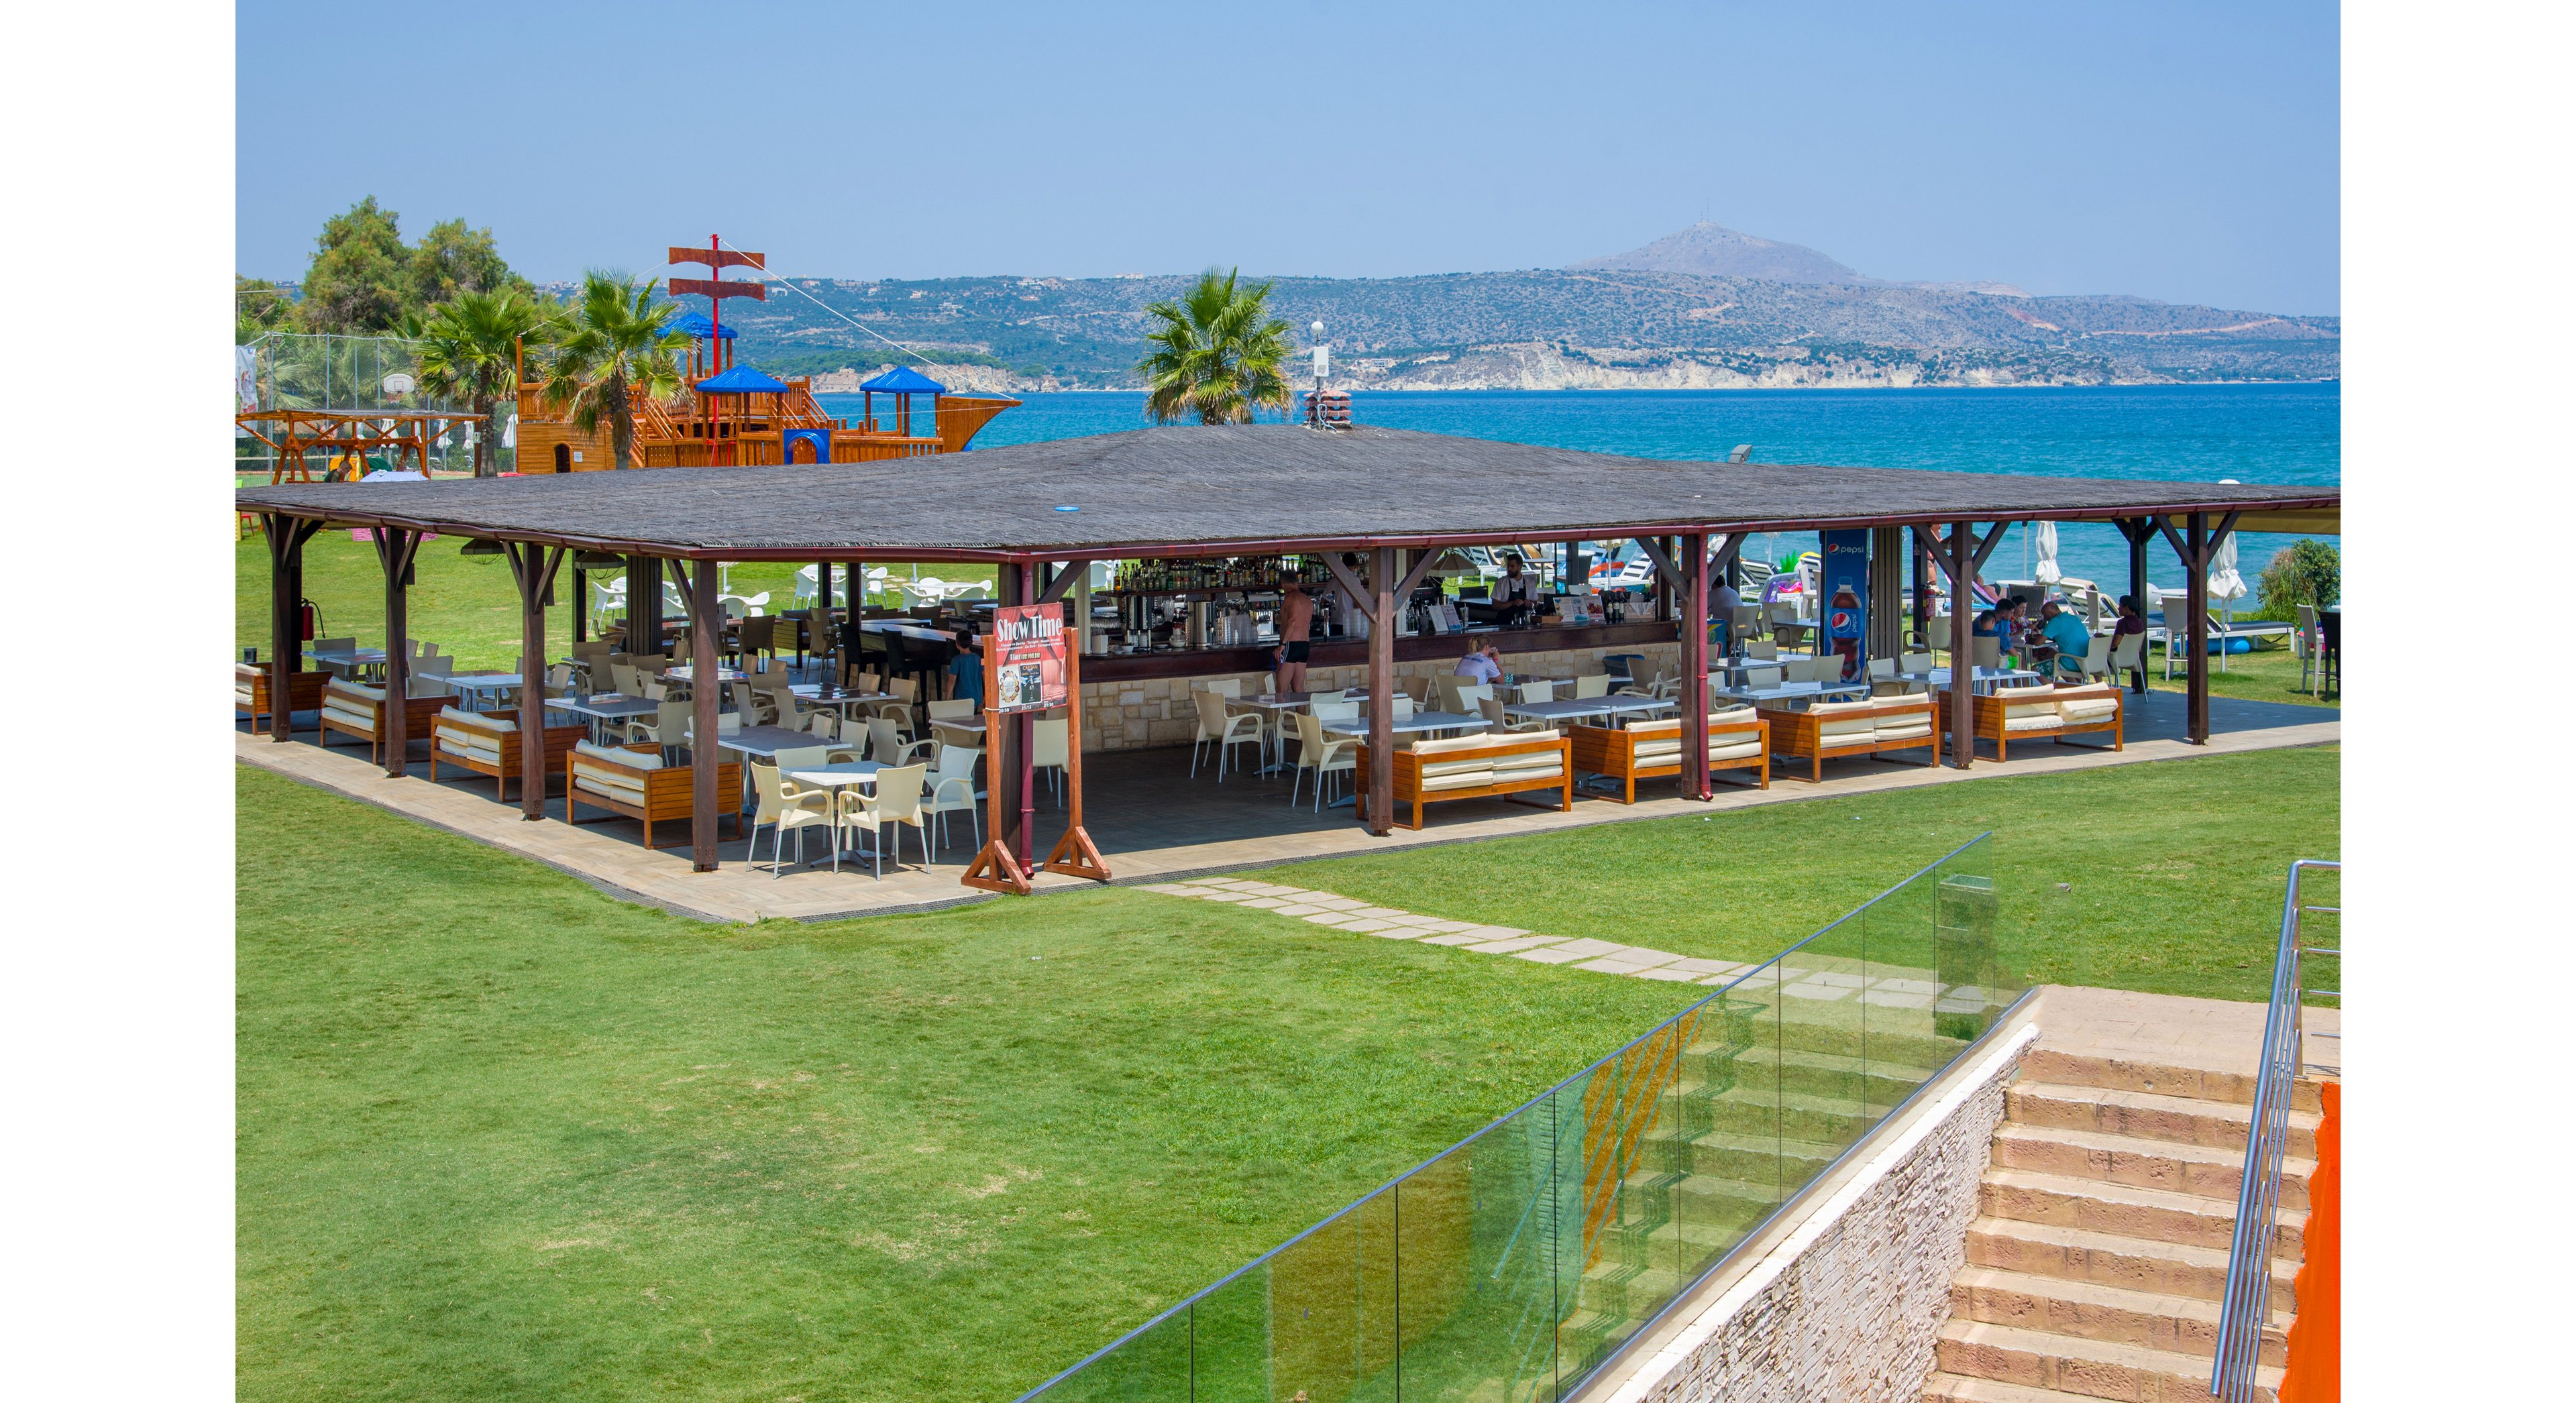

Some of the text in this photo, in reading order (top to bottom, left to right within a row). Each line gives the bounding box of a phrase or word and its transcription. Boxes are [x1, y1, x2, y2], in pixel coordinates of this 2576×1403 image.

[1841, 546, 1864, 554] pepsi
[997, 615, 1063, 642] Show Time
